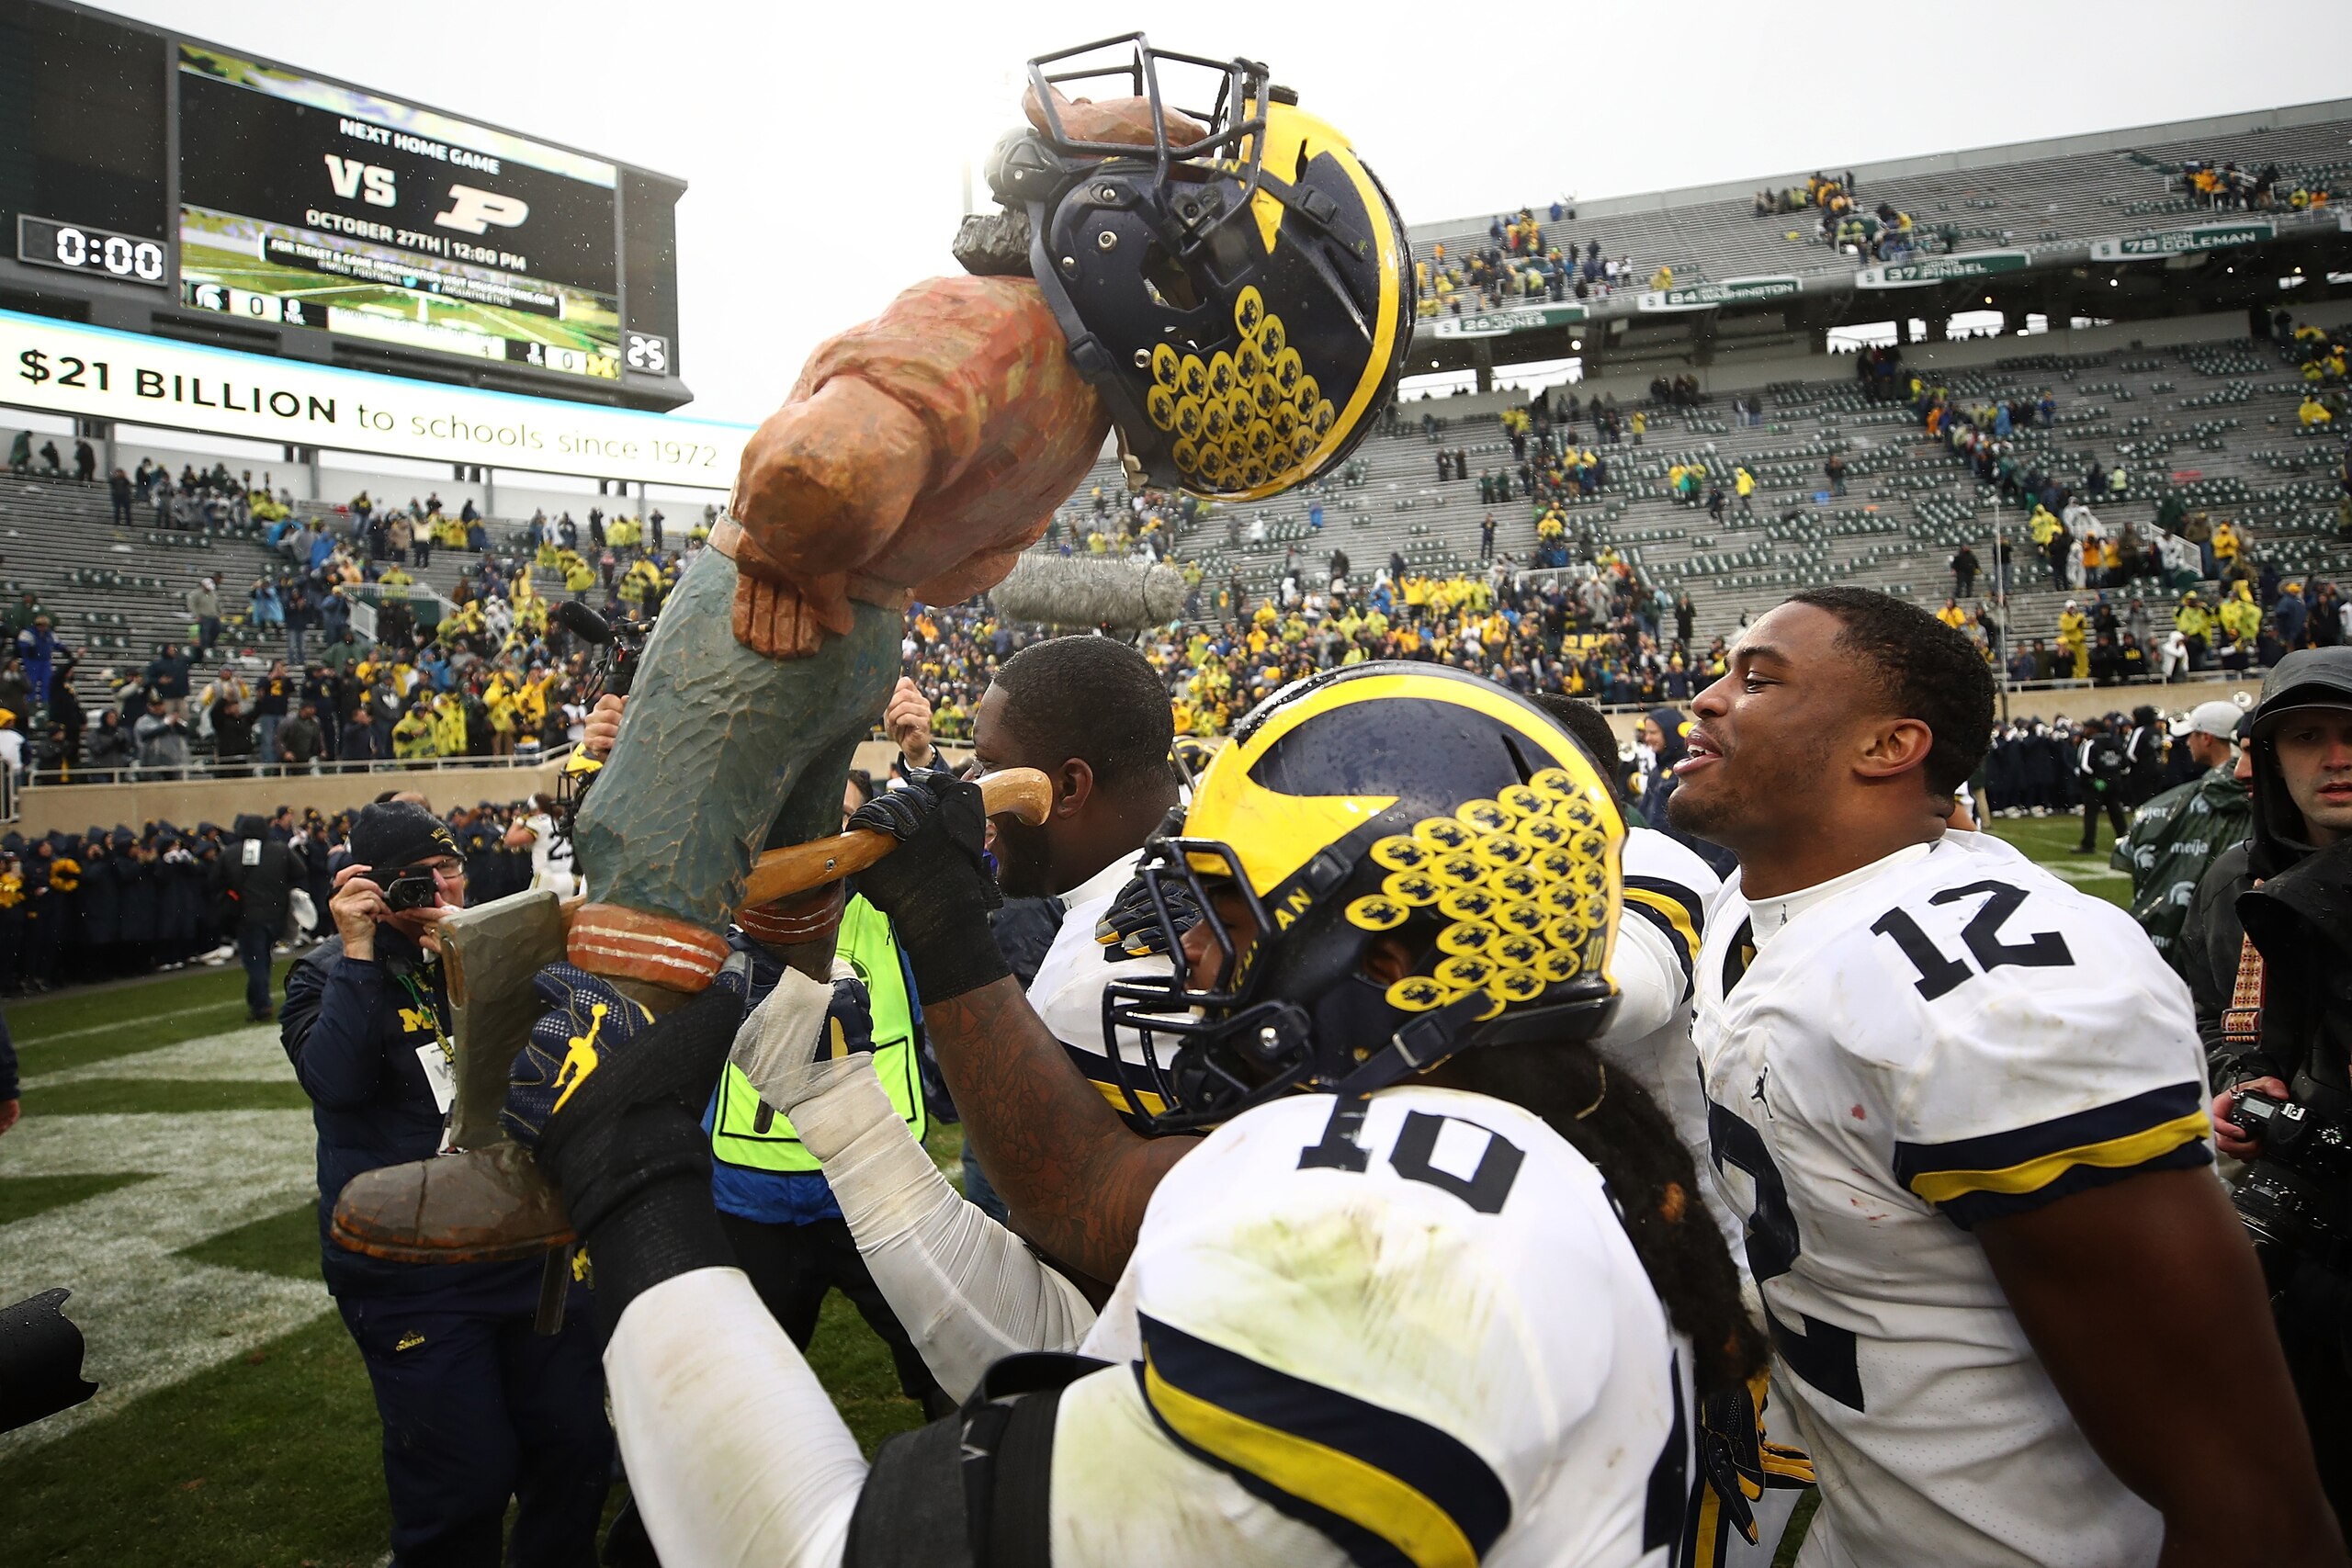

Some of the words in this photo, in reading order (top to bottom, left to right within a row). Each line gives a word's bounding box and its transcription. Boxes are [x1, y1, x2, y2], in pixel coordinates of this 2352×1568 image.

[340, 118, 392, 145] NEXT
[394, 133, 447, 161] HOME
[449, 149, 501, 175] GAME
[324, 153, 397, 208] VS
[434, 184, 530, 235] P
[56, 227, 163, 279] 0:00
[306, 209, 394, 243] OCTOBER
[396, 229, 441, 253] 27TH
[452, 242, 498, 265] 12:00
[499, 252, 526, 272] PM
[2124, 239, 2158, 254] 78
[2161, 231, 2256, 253] COLEMAN
[271, 239, 295, 254] FOR
[295, 243, 333, 261] TICKET
[343, 254, 373, 267] GAME
[373, 260, 442, 283] INFORMATION
[1922, 263, 1989, 279] PINGEL
[250, 296, 264, 316] 0
[1668, 290, 1698, 303] 84
[1701, 283, 1795, 301] WASHINGTON
[1464, 318, 1490, 331] 26
[1493, 316, 1548, 330] JONES
[562, 352, 573, 369] 0
[627, 335, 665, 371] 25
[19, 349, 109, 391] $21
[137, 368, 336, 423] BILLION
[357, 403, 395, 432] to
[412, 414, 544, 451] schools
[559, 430, 638, 460] since
[653, 439, 718, 468] 1972
[1870, 879, 2075, 1002] 12
[1296, 1095, 1527, 1214] 10
[396, 1336, 425, 1352] adidas
